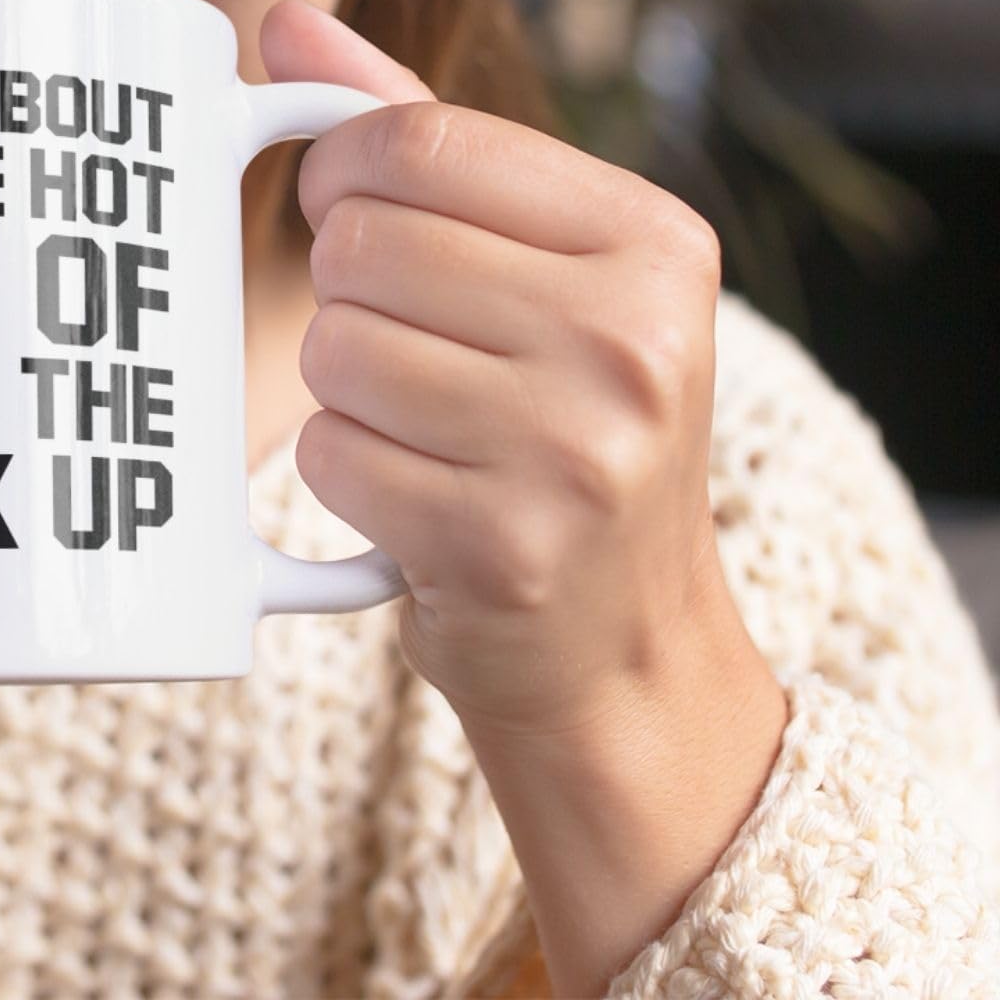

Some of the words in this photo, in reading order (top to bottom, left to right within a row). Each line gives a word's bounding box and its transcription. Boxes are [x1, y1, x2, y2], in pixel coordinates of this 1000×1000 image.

[29, 147, 175, 234] HOT
[36, 235, 170, 352] OF
[20, 356, 174, 449] THE
[52, 455, 174, 551] UP
